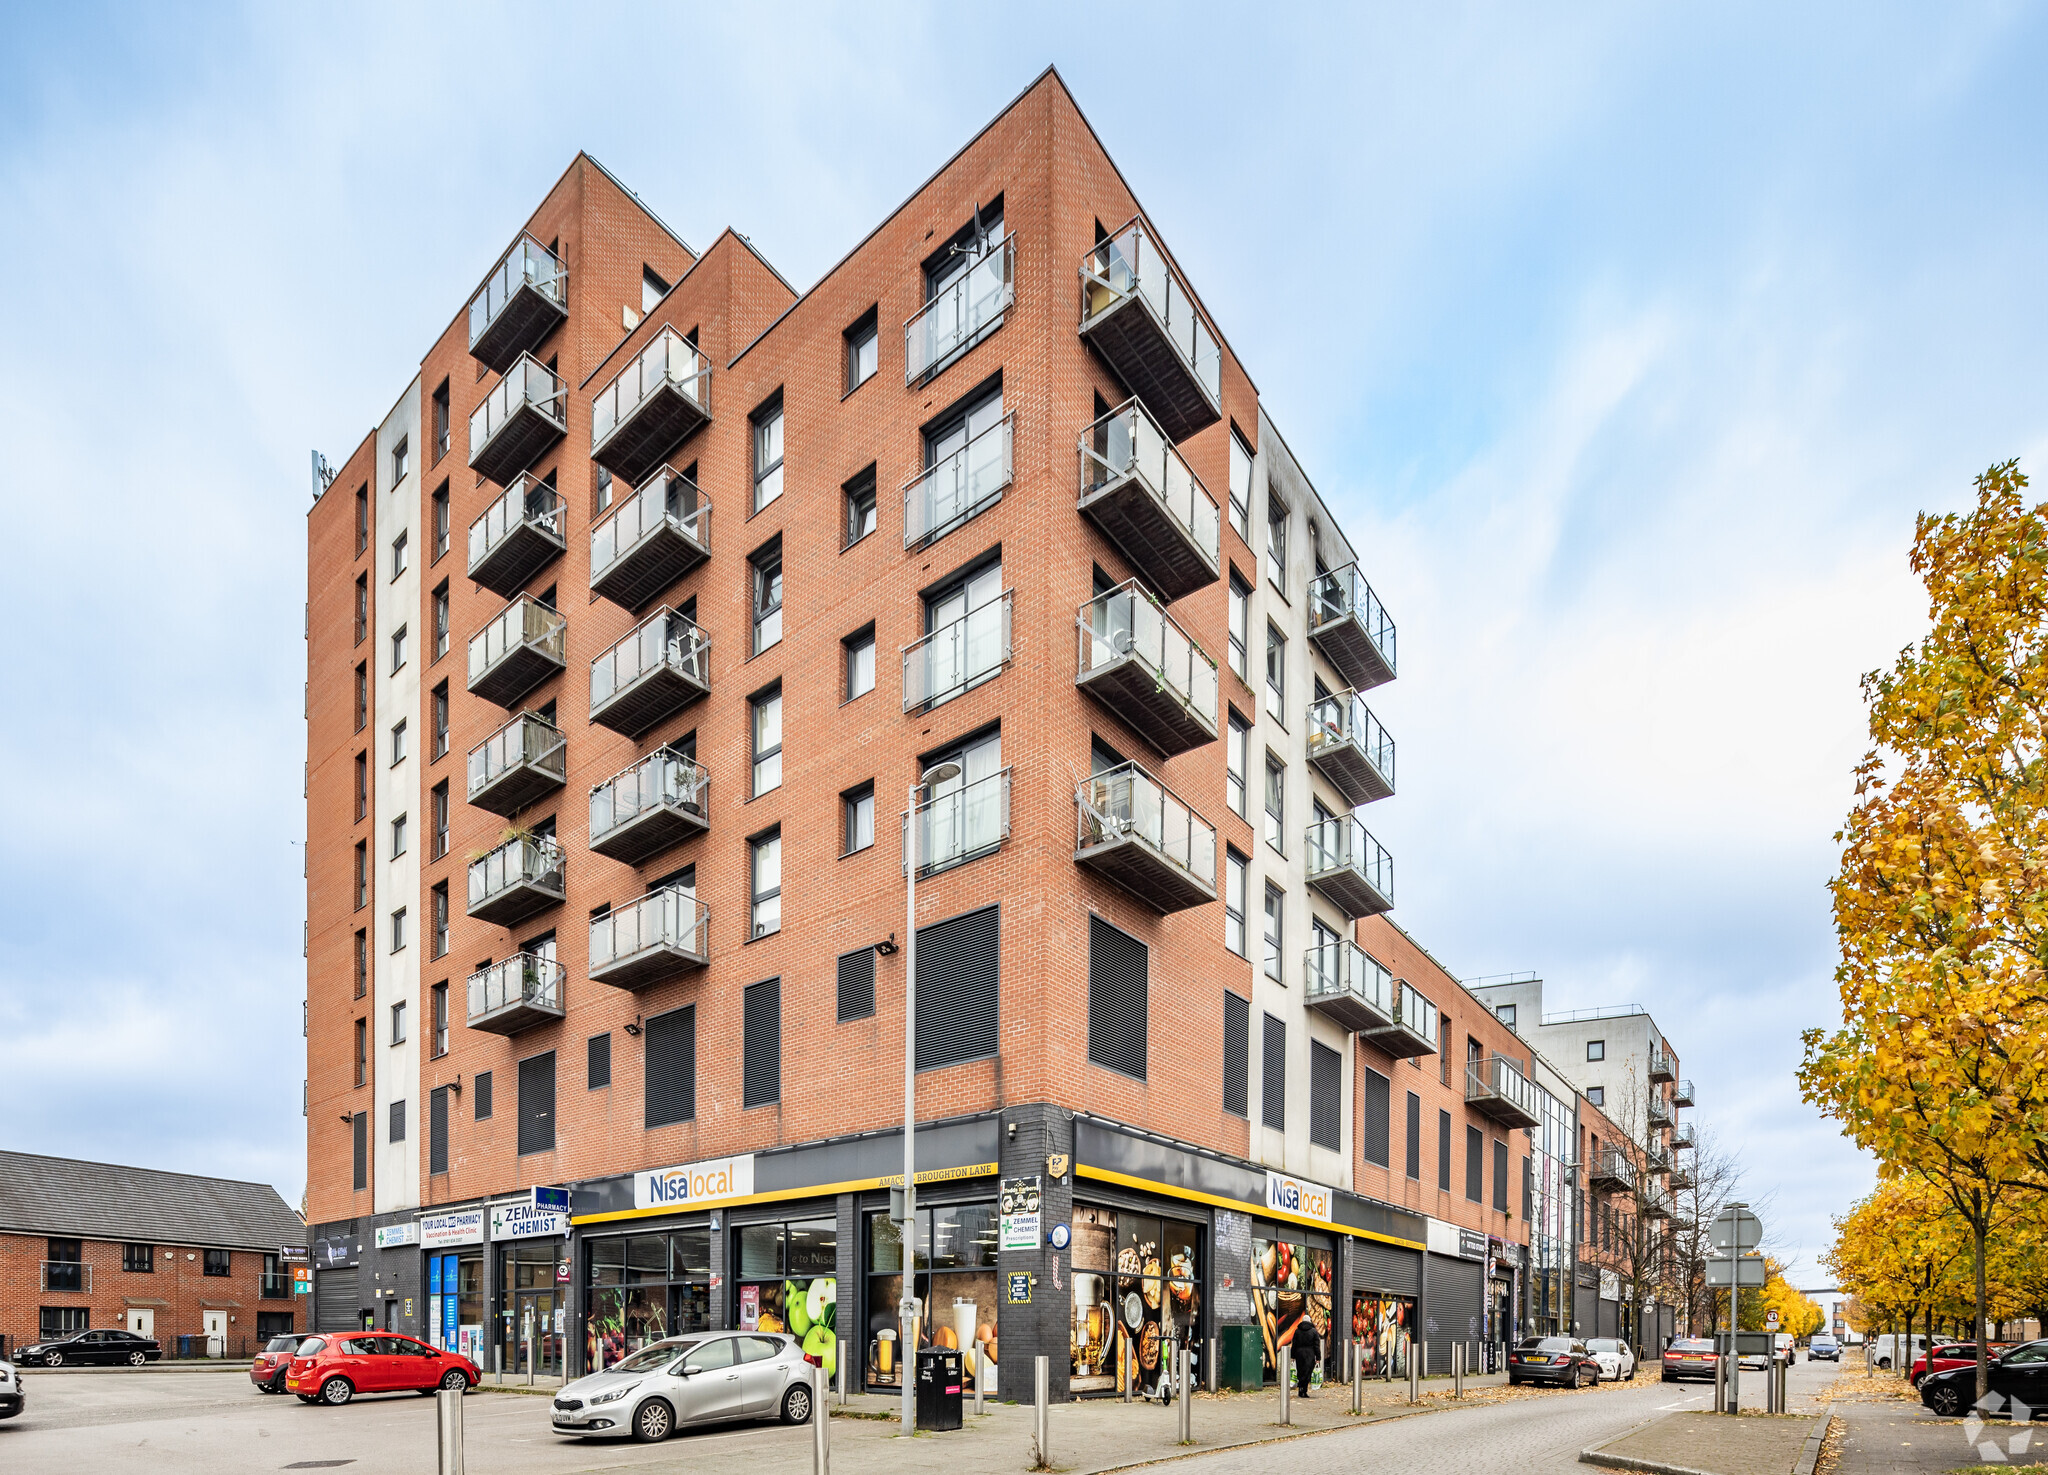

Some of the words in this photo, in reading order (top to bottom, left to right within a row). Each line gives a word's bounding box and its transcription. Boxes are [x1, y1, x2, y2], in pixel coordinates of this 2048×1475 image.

[879, 1176, 906, 1187] AMACO
[917, 1167, 968, 1183] BROUGHTON
[969, 1164, 992, 1176] LANE
[536, 1202, 567, 1212] PHARMACY
[505, 1205, 556, 1222] ZEM
[422, 1220, 433, 1230] YOUR
[433, 1218, 447, 1229] LOCAL
[456, 1213, 481, 1226] PHARMACY
[512, 1217, 556, 1235] CHEMIST
[1013, 1216, 1038, 1225] ZEMMEL
[386, 1226, 404, 1237] ZEMMEL
[1013, 1225, 1038, 1233] CHEMIST
[386, 1235, 404, 1245] CHEMIST
[811, 1252, 835, 1264] Nisa
